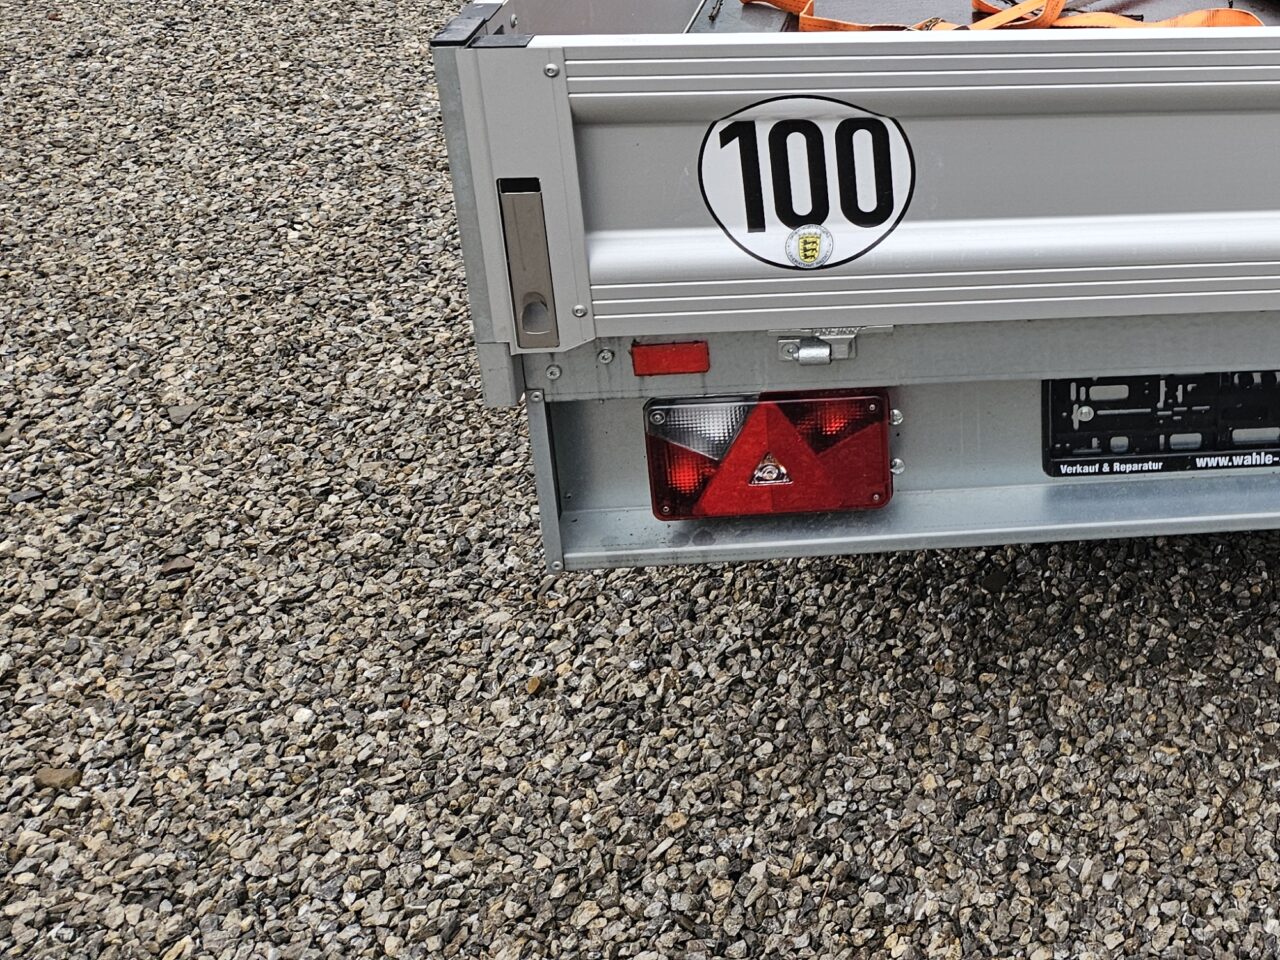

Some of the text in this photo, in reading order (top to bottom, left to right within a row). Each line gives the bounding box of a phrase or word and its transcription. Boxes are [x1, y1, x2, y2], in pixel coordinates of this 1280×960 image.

[719, 118, 894, 233] 100
[1060, 460, 1163, 474] Verkauf & Reparatur
